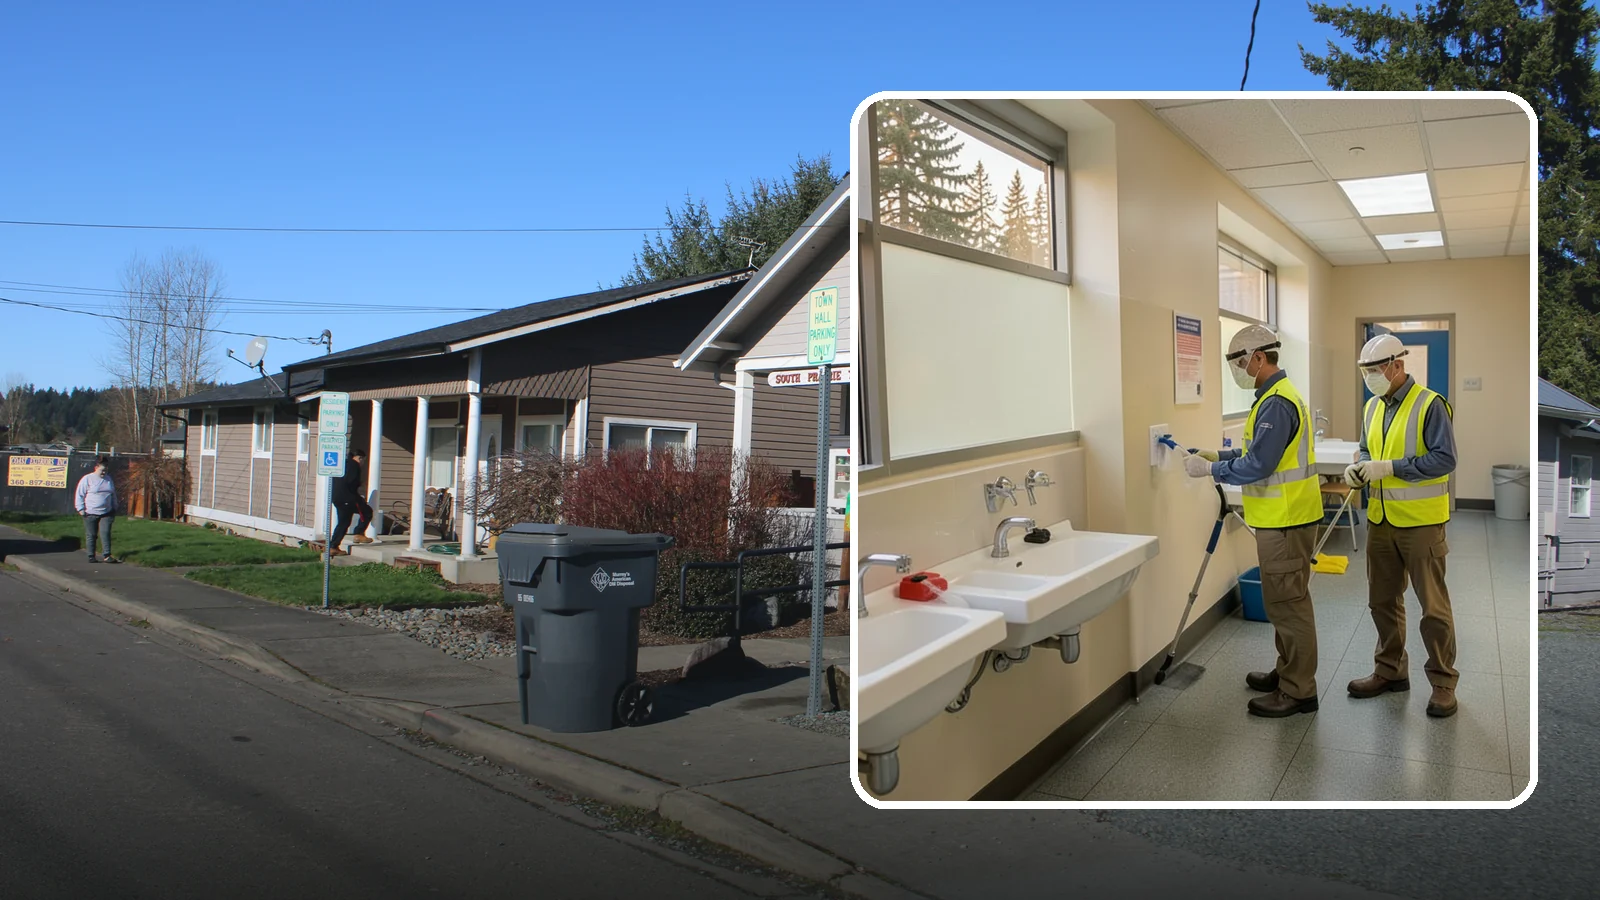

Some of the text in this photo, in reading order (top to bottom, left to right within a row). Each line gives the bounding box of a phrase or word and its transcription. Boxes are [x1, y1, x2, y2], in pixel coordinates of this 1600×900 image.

[815, 294, 832, 308] TOWN
[814, 312, 831, 324] HALL
[810, 326, 836, 340] PARKING
[814, 344, 830, 357] ONLY
[776, 374, 801, 384] SOUTH
